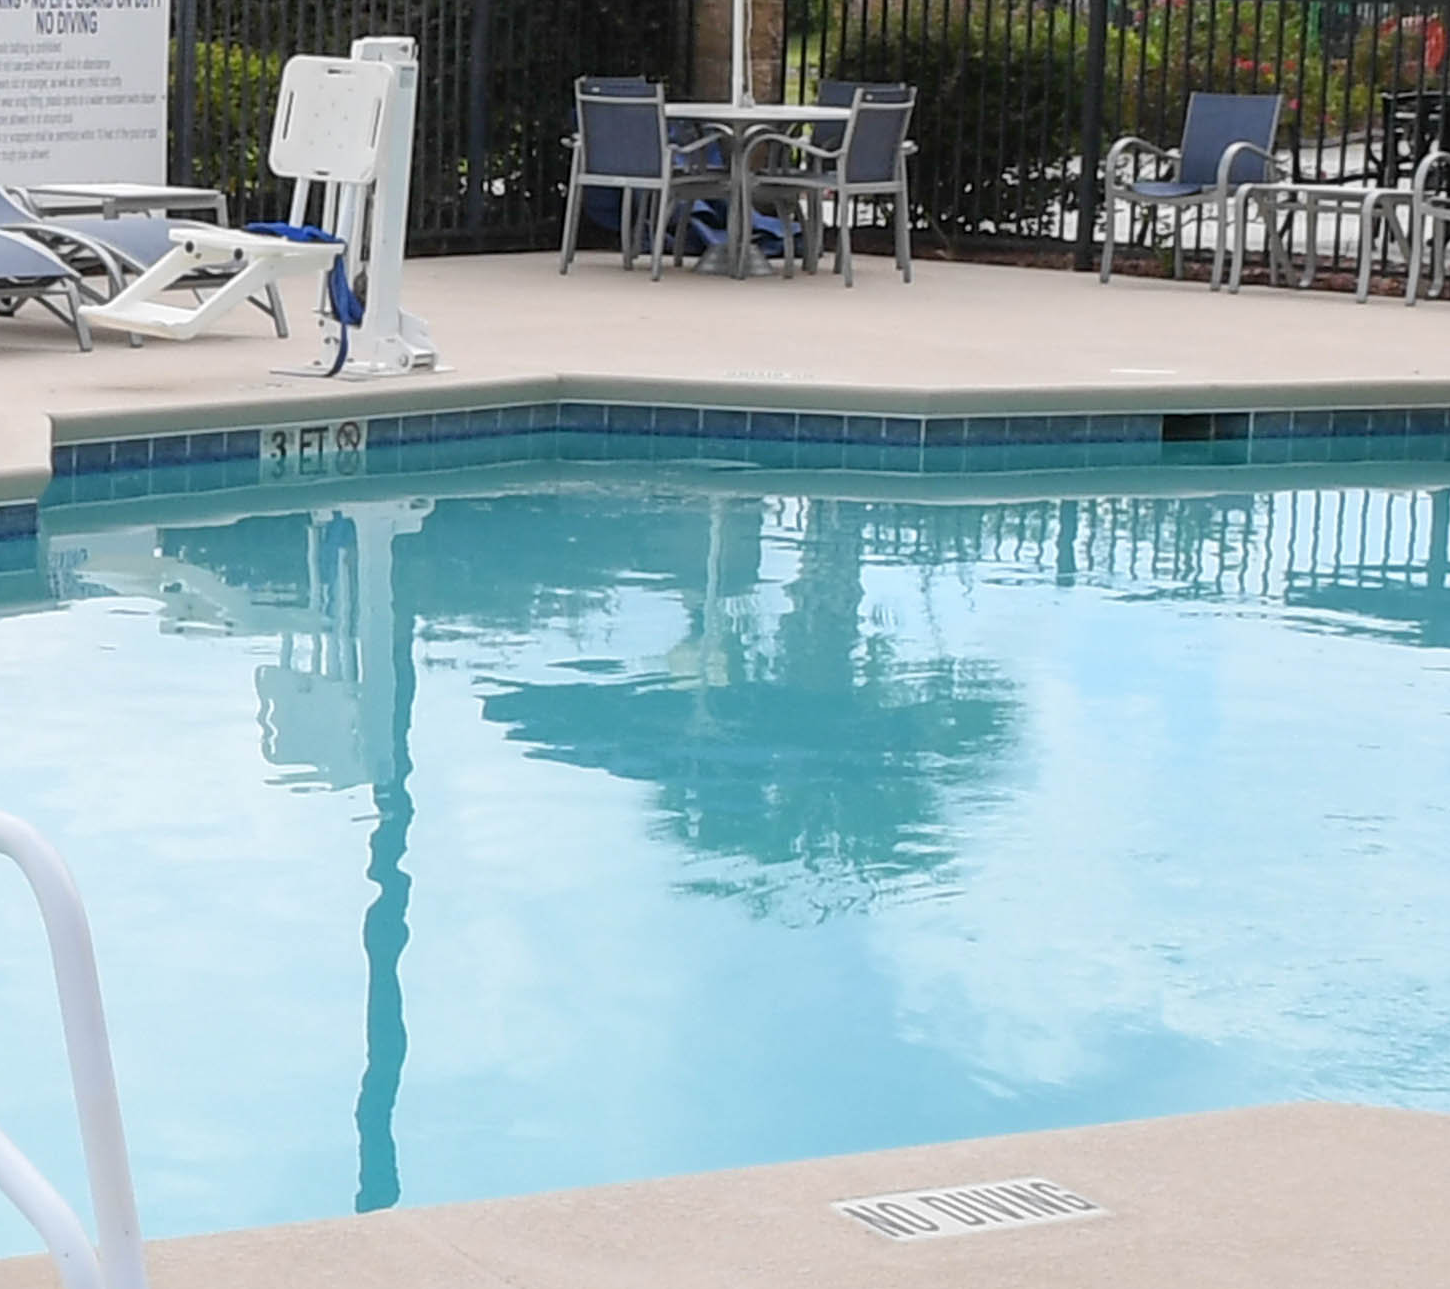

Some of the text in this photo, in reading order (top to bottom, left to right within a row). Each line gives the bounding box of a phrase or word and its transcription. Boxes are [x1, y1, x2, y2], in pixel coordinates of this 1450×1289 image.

[36, 11, 98, 34] NO DIVING
[270, 426, 329, 458] 3 FT
[843, 1181, 1098, 1237] NO DIVING
